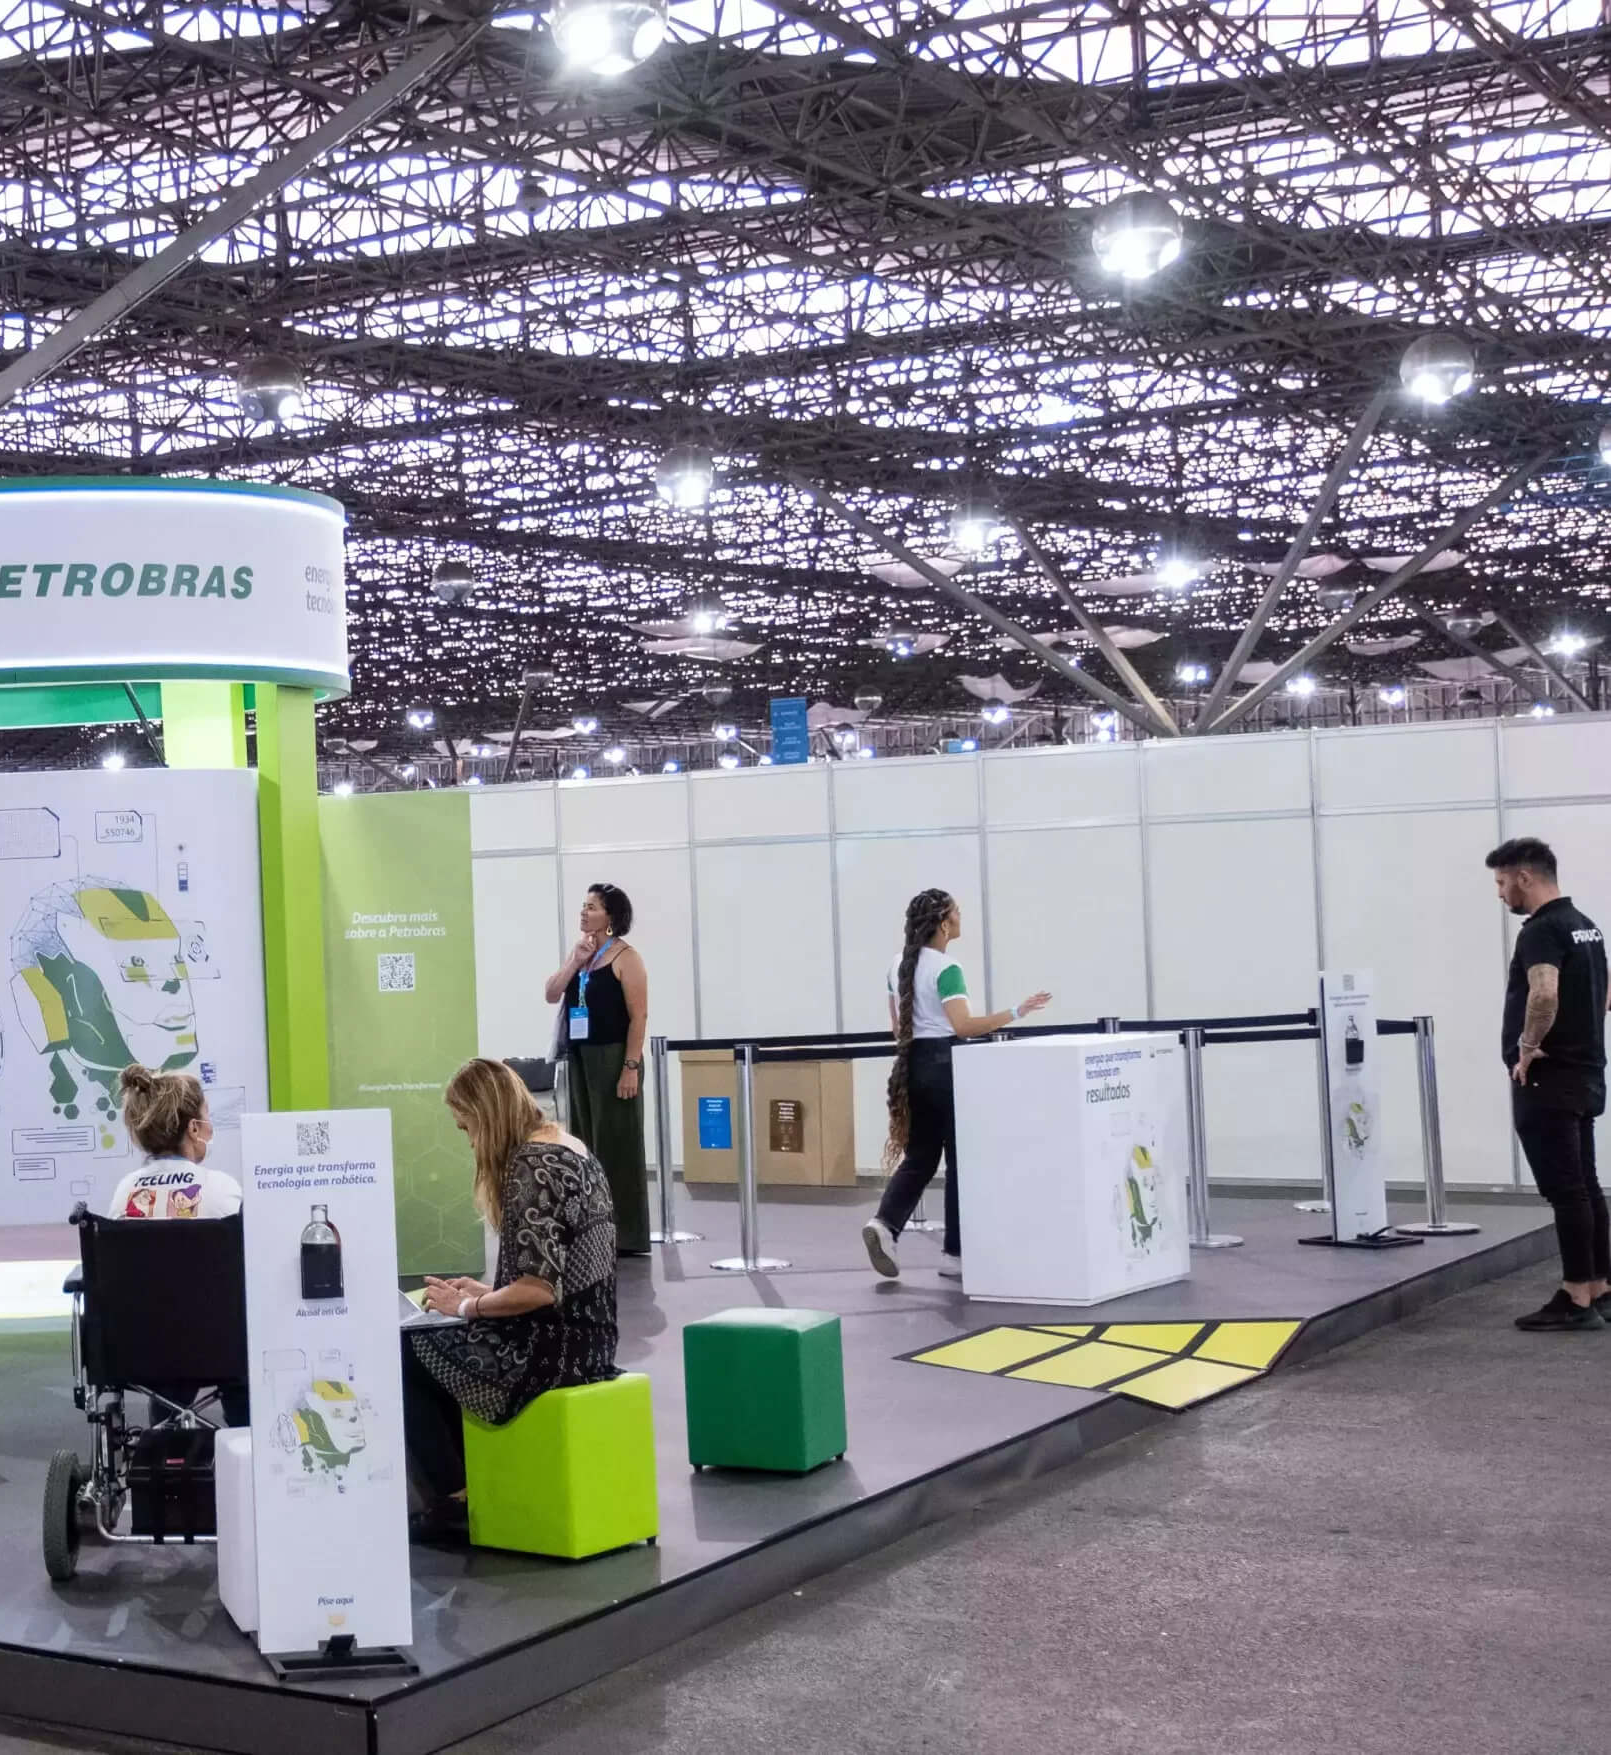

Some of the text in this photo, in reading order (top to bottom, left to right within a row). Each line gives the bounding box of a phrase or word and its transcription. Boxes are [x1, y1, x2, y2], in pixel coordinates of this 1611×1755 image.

[352, 908, 438, 924] Descubra mais
[344, 923, 446, 940] sobre a Petrobras
[1086, 1080, 1131, 1104] resultados
[254, 1160, 376, 1177] Energia que transforma
[257, 1174, 377, 1190] tecnologia em robótica.
[335, 1305, 349, 1316] Gel
